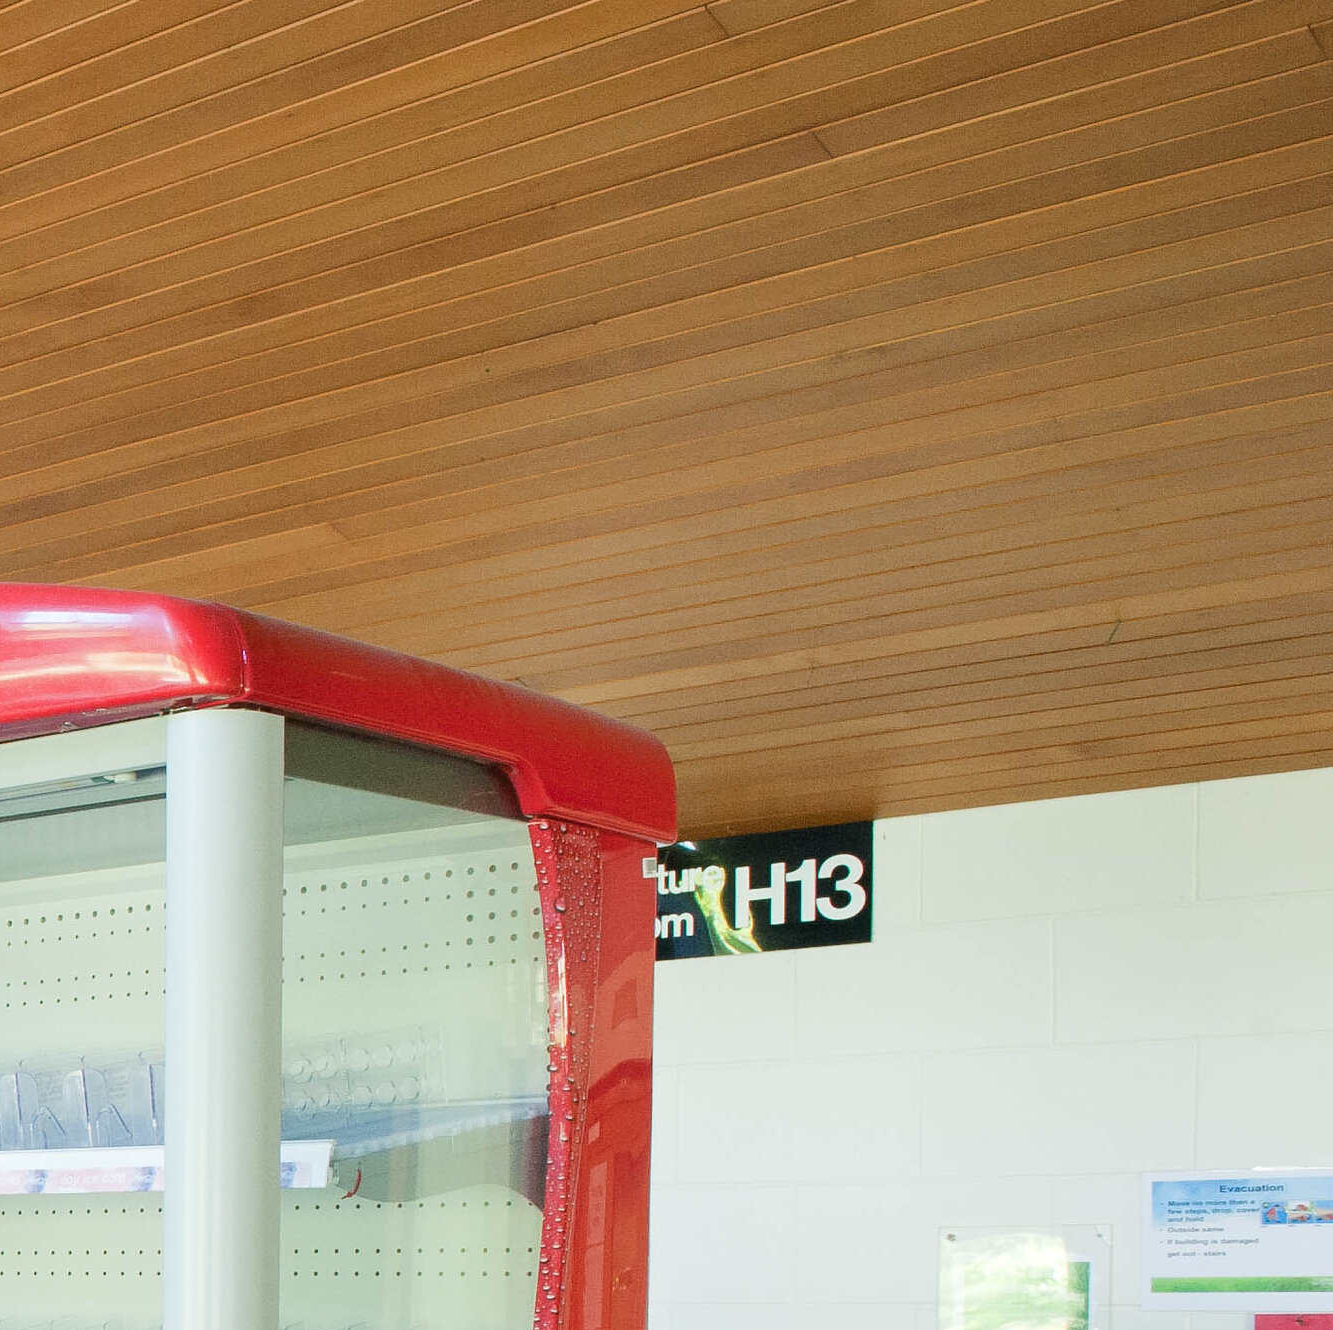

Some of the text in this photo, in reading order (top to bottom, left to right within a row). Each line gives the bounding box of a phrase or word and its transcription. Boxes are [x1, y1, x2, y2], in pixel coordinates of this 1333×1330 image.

[734, 853, 867, 929] H13
[1219, 1184, 1284, 1193] Evacuation
[1174, 1238, 1208, 1246] building
[1220, 1238, 1259, 1246] damaged
